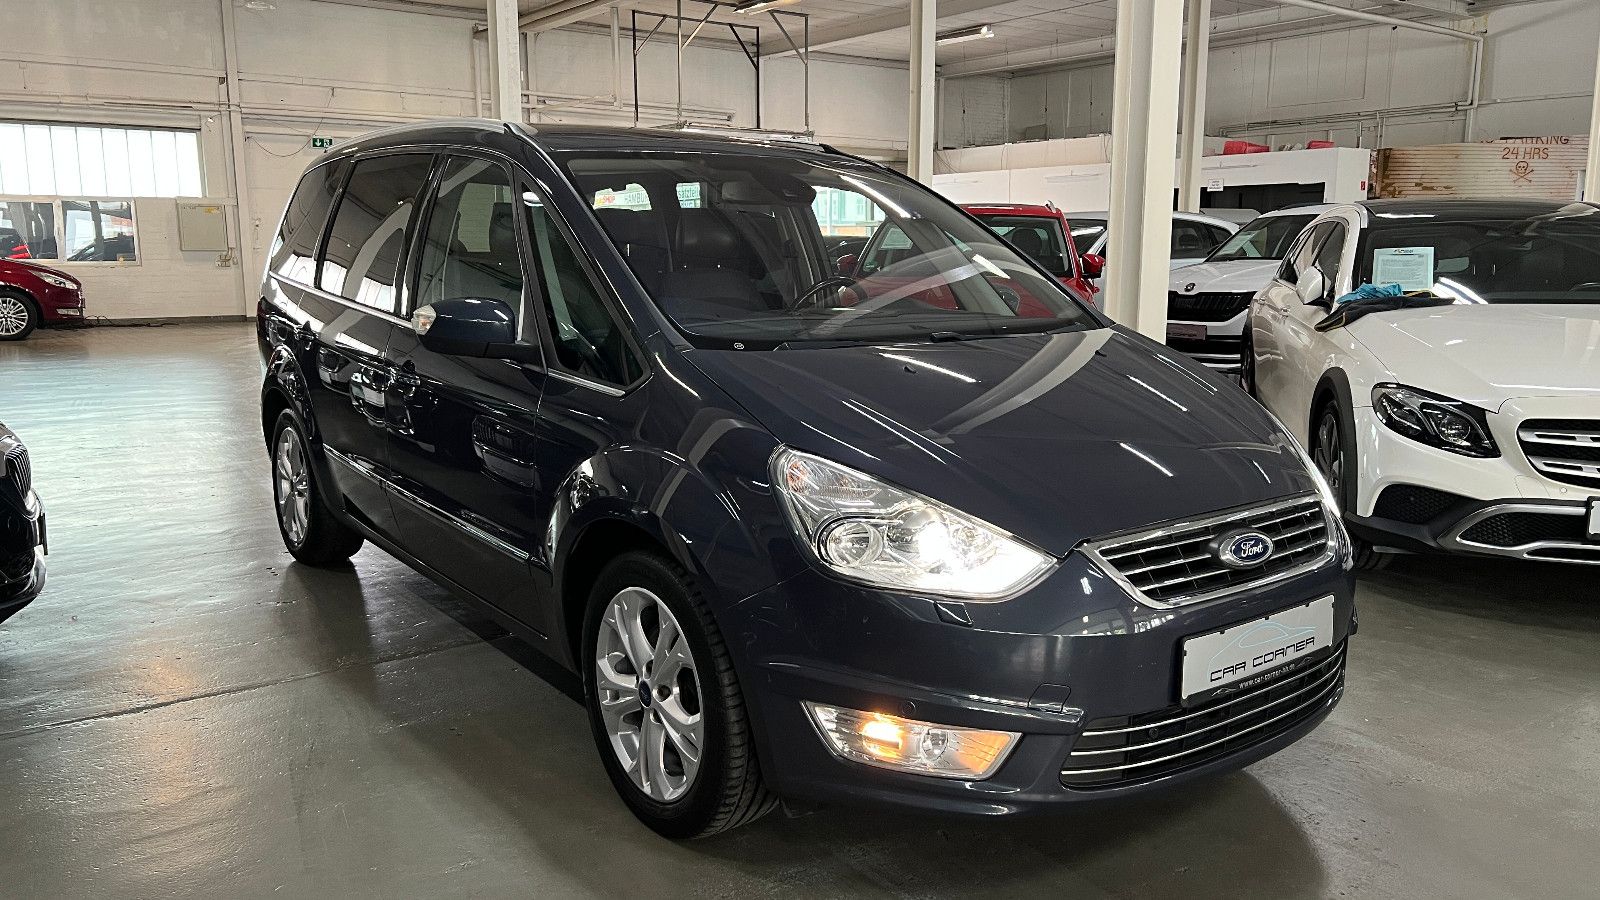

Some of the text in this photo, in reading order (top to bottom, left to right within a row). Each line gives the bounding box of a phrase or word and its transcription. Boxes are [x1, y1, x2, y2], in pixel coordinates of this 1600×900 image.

[1502, 147, 1549, 160] 24 HRS
[1241, 540, 1263, 557] Ford
[1210, 636, 1315, 682] CAR CORNER
